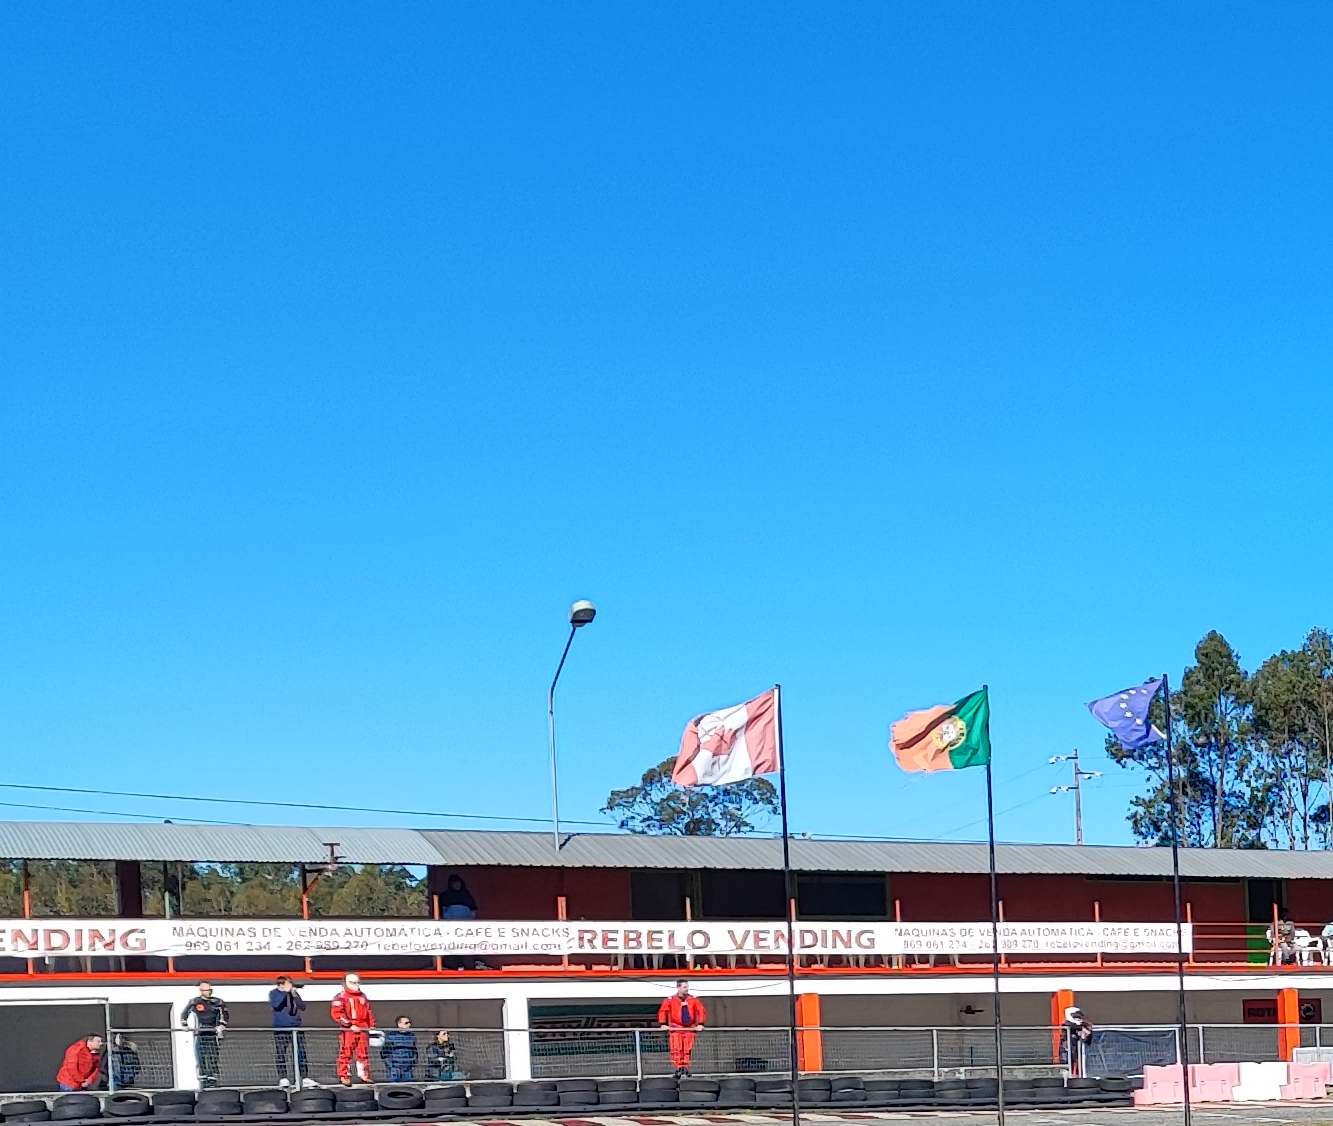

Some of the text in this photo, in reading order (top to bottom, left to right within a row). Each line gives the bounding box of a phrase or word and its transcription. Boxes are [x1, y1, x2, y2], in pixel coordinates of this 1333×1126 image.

[172, 924, 256, 938] MÁQUINAS
[262, 926, 281, 938] DE
[288, 926, 340, 938] VENDA
[343, 924, 442, 938] AUTOMÁTICA
[454, 924, 490, 938] CAFÉ
[498, 927, 506, 938] E
[511, 927, 570, 938] SNACKS
[960, 928, 974, 937] DE
[979, 928, 1017, 937] VENDA
[1133, 928, 1140, 937] E
[0, 928, 146, 951] NDING
[185, 940, 210, 951] 969
[215, 940, 239, 951] 061
[246, 940, 271, 951] 234
[286, 940, 311, 951] 262
[577, 929, 876, 950] REBELO VENDING
